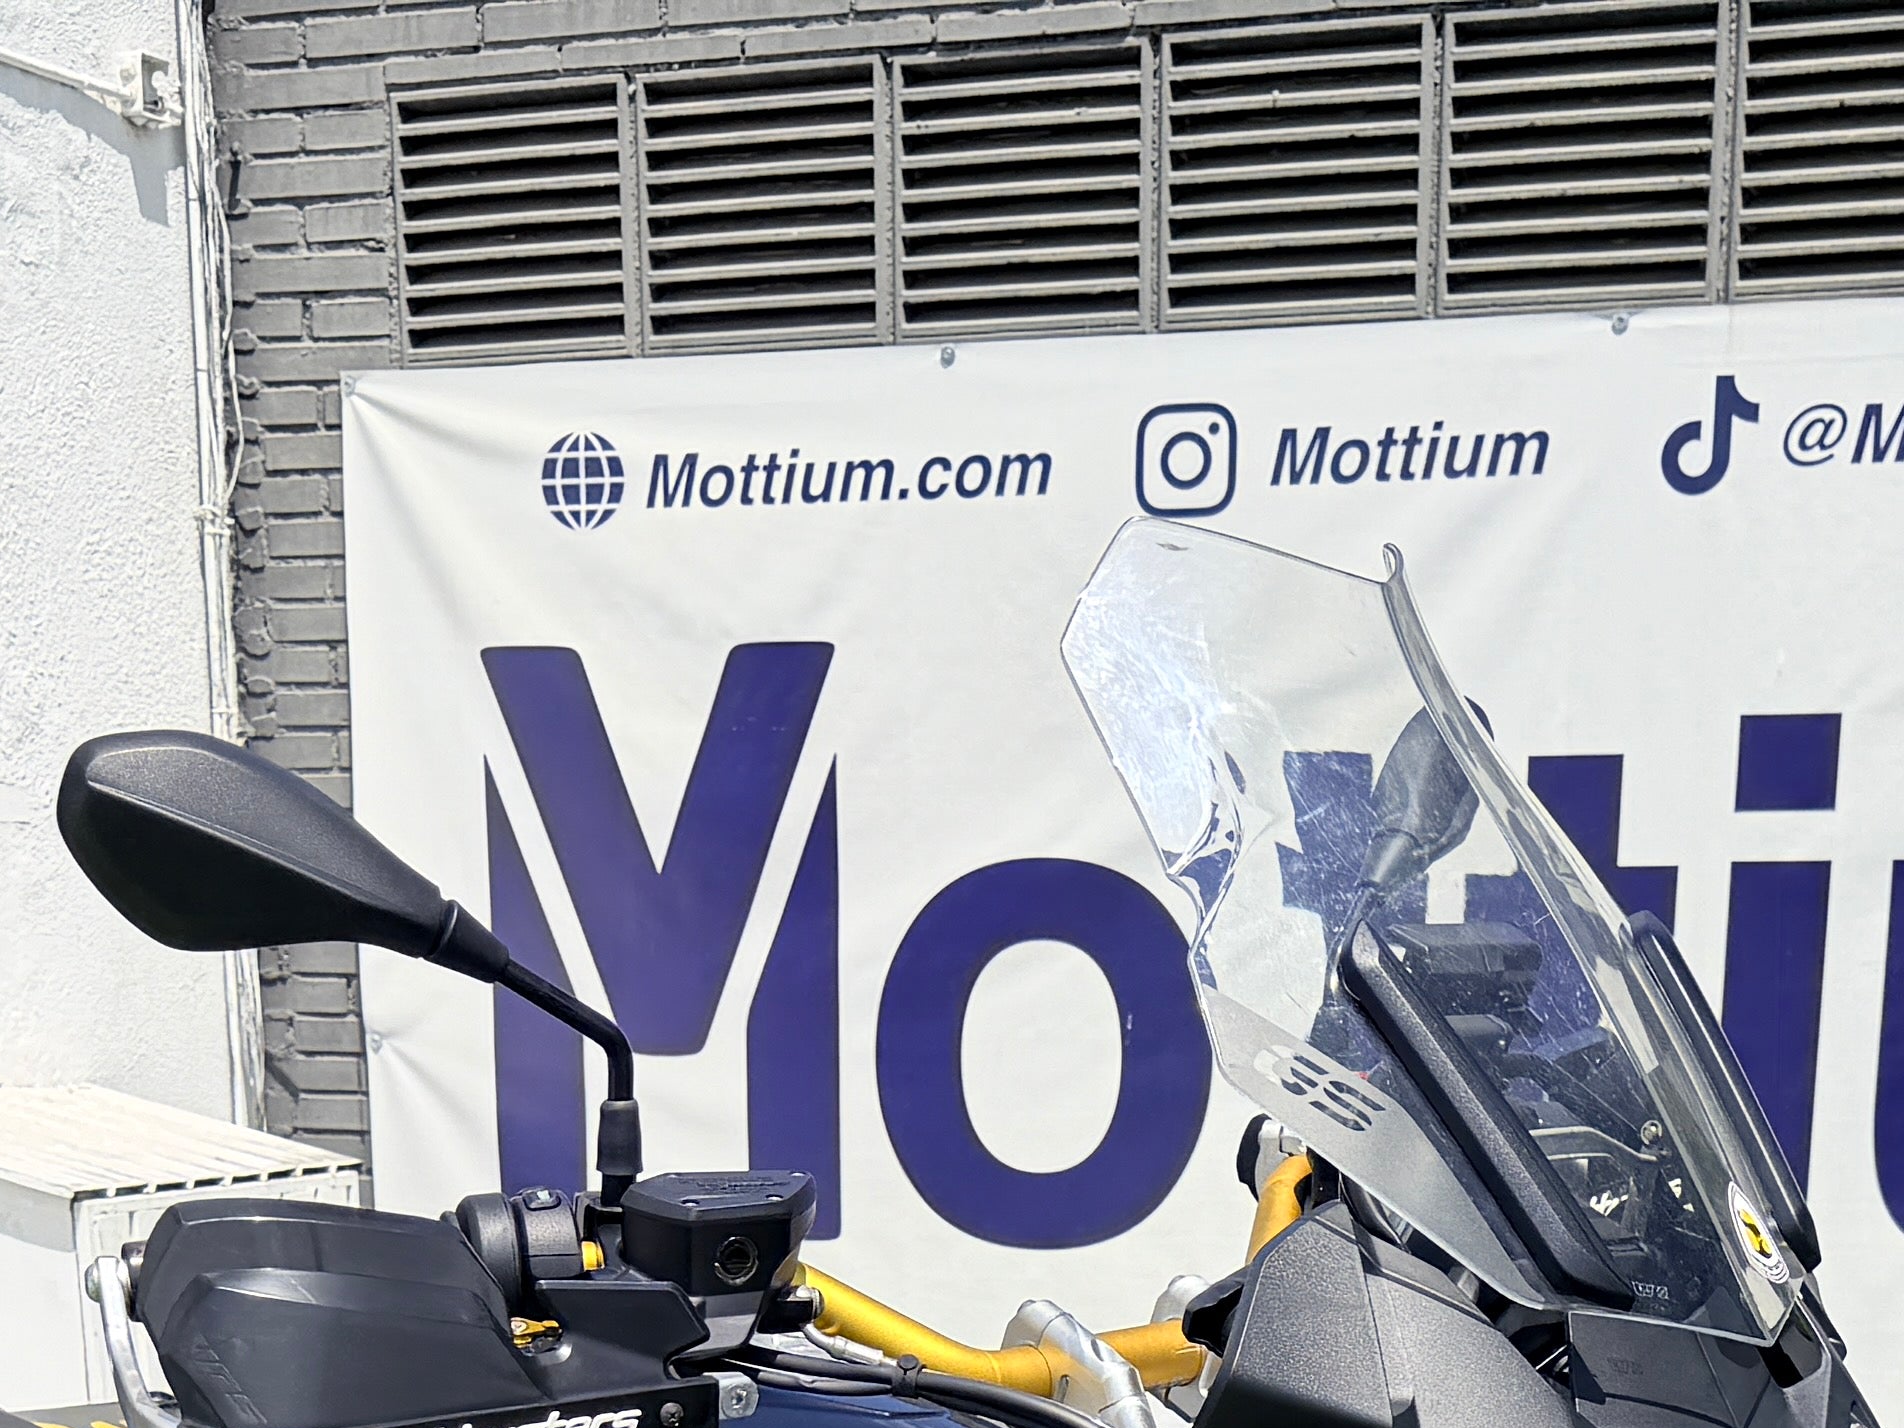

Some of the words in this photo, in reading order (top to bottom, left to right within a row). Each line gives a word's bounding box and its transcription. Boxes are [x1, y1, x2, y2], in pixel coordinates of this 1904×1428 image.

[647, 449, 1052, 509] Mottium.com
[1270, 420, 1550, 486] Mottium
[1253, 1044, 1386, 1131] GS
